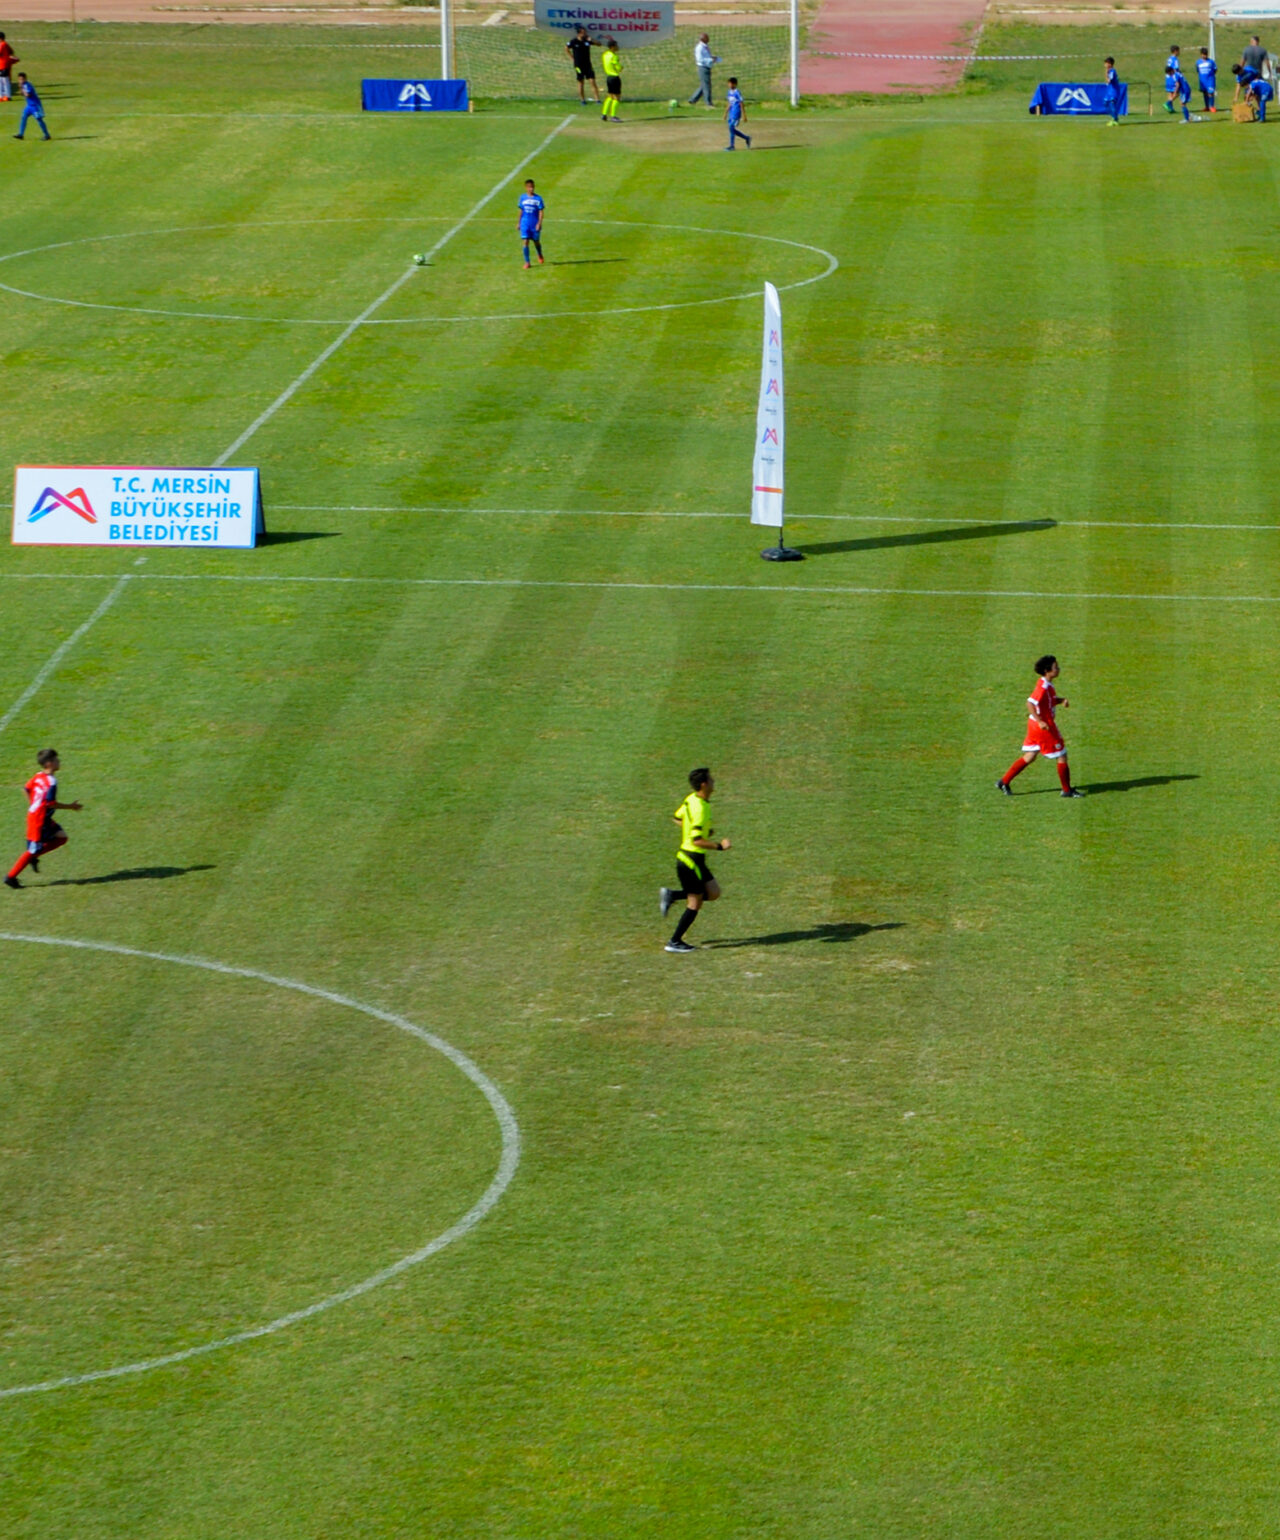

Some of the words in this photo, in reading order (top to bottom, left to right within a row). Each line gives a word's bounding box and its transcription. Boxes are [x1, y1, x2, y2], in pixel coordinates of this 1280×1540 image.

[547, 7, 662, 20] ETKİNLİĞİMİZE
[587, 21, 660, 32] GELDİNİZ
[112, 476, 146, 494] T.C.
[151, 473, 231, 495] MERSİN
[110, 496, 241, 523] BÜYÜKŞEHİR
[109, 519, 219, 542] BELEDİYESİ
